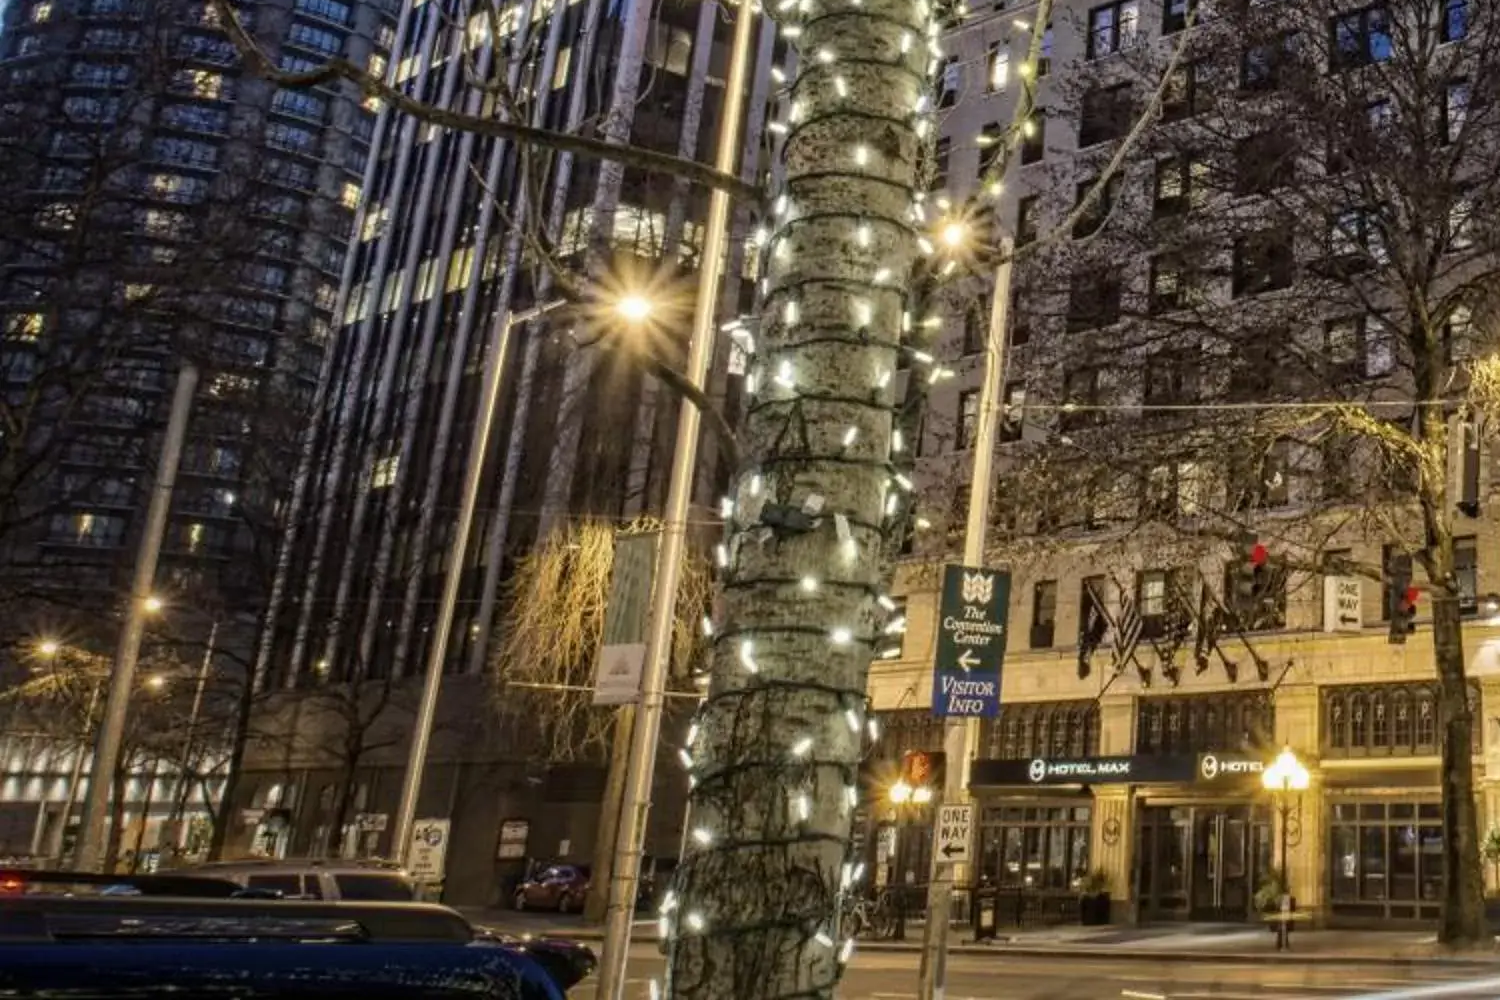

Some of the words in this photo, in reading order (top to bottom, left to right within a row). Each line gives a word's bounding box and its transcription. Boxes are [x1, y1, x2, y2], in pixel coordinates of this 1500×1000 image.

[963, 605, 987, 620] The
[943, 615, 1003, 635] Convention
[953, 631, 992, 646] Center
[941, 675, 995, 697] VISITOR
[947, 694, 985, 714] INFO
[1047, 763, 1096, 775] HOTEL
[1097, 762, 1131, 774] MAX
[1220, 761, 1265, 772] HOTEL
[943, 808, 969, 824] ONE
[941, 826, 968, 839] WAY
